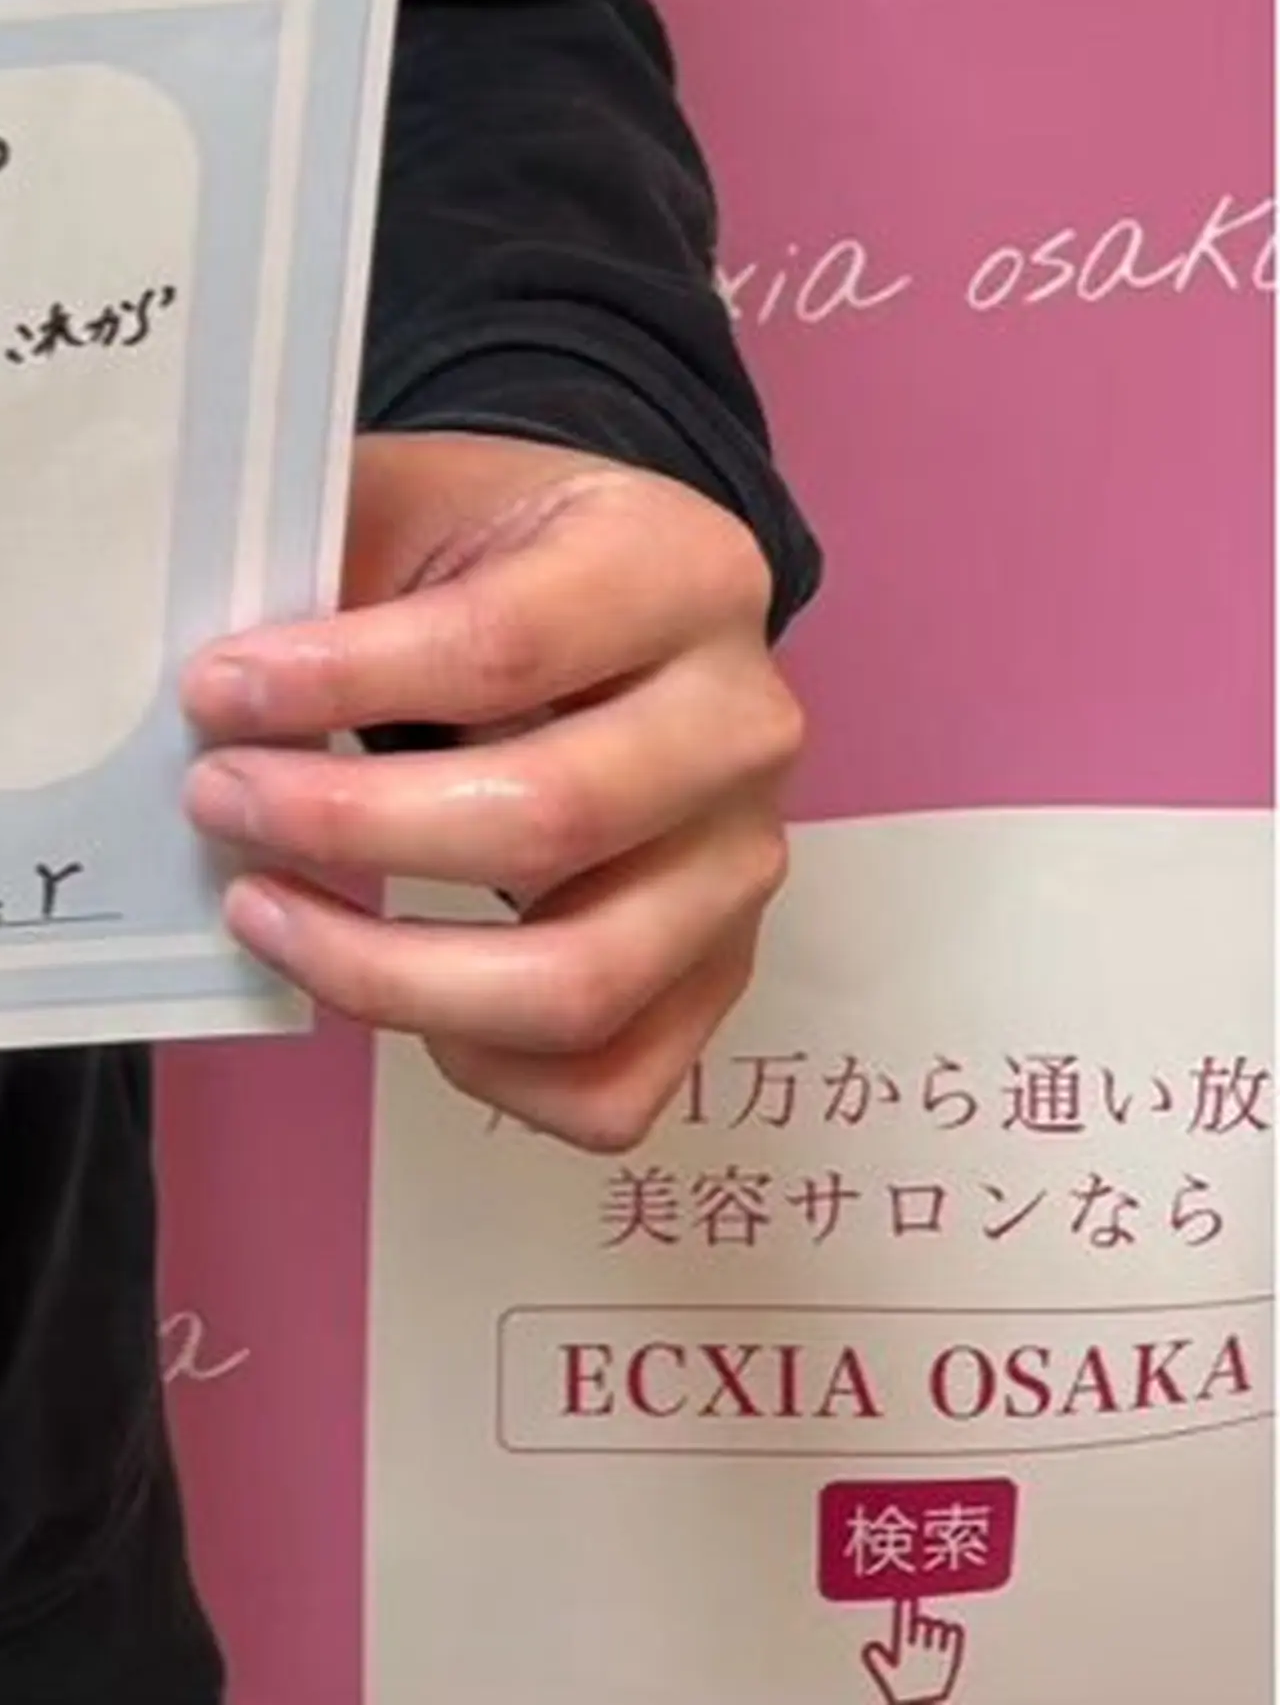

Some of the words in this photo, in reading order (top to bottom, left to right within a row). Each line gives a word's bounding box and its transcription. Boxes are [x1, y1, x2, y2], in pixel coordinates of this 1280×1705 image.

[483, 1051, 1276, 1135] 1万から通い放
[598, 1164, 1226, 1250] 美容サロンなら
[558, 1342, 885, 1420] ECXIA
[928, 1332, 1253, 1422] OSAKA
[842, 1503, 990, 1577] 検索
